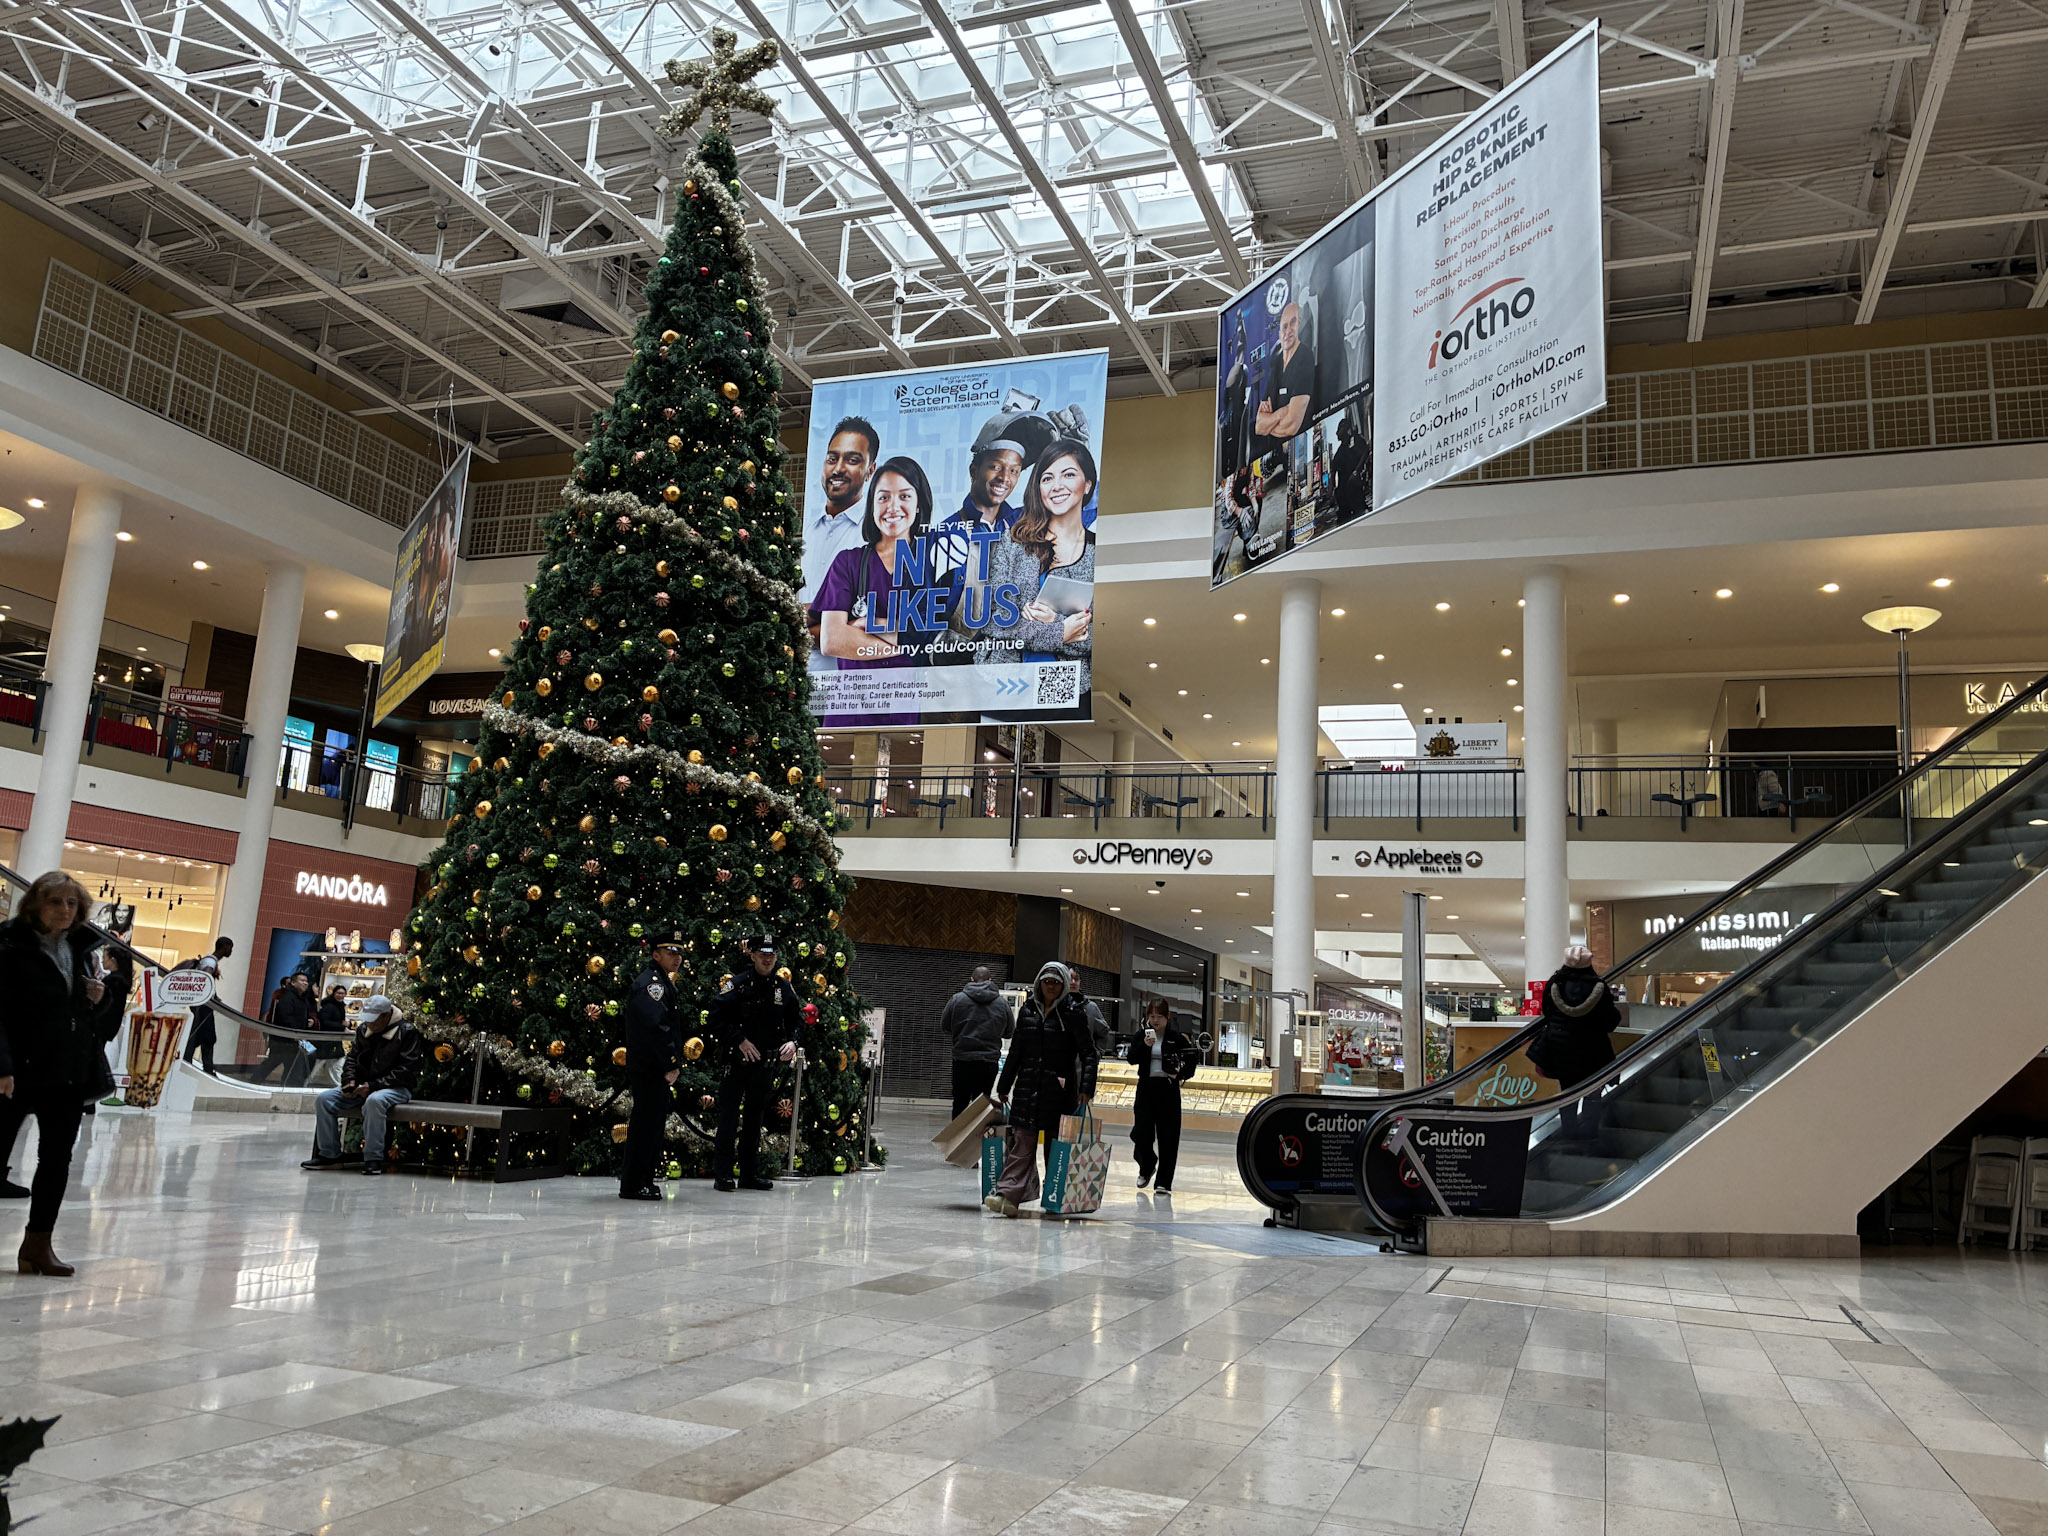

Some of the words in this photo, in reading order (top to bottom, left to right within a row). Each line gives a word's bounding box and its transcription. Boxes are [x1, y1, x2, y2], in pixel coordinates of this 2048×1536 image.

[1439, 104, 1521, 174] ROBOTIC
[1432, 166, 1461, 197] HIP
[1464, 156, 1477, 174] &
[1480, 117, 1528, 163] KNEE
[1416, 123, 1548, 228] REPLACEMENT
[1472, 177, 1516, 212] Procedure
[1444, 219, 1481, 248] Precision
[1484, 195, 1515, 220] Results
[1434, 251, 1458, 270] Same
[1461, 238, 1478, 254] Day
[1481, 206, 1525, 241] Discharge
[1415, 262, 1462, 299] Top-Ranked
[1465, 236, 1501, 268] Hospital
[1503, 208, 1550, 243] Affiliation
[1413, 286, 1455, 318] Nationally
[1457, 250, 1506, 290] Recognized
[1509, 224, 1554, 257] Expertise
[1428, 287, 1535, 370] iortho
[1424, 373, 1438, 386] THE
[1441, 344, 1493, 377] ORTHOPEDIC
[1495, 318, 1538, 348] INSTITUTE
[913, 384, 968, 396] College
[972, 379, 989, 391] of
[1361, 383, 1370, 393] MD
[1409, 403, 1425, 423] Call
[1427, 400, 1441, 415] For
[1445, 371, 1494, 405] Immediate
[1497, 338, 1559, 377] Consultation
[899, 407, 926, 415] WORKFORCE
[927, 404, 960, 412] DEVELOPMENT
[971, 400, 1000, 408] INNOVATION
[900, 396, 950, 408] Staten
[954, 388, 1000, 403] Island
[1388, 405, 1468, 453] 833-GO-iOrtho
[1491, 344, 1585, 401] iOrthoMD.com
[1391, 448, 1427, 473] TRAUMA
[1436, 417, 1486, 449] ARTHRITIS
[1498, 392, 1538, 420] SPORTS
[1550, 368, 1584, 394] SPINE
[1403, 434, 1484, 480] COMPREHENSIVE
[1488, 418, 1514, 438] CARE
[1519, 391, 1569, 424] FACILITY
[1296, 504, 1314, 520] BEST
[415, 522, 429, 551] care
[919, 520, 975, 534] THEY'RE
[1258, 543, 1277, 557] Health
[865, 587, 951, 635] LIKE
[963, 583, 1021, 630] US
[856, 639, 1025, 658] csi.cuny.edu/continue
[821, 674, 841, 683] Hiring
[844, 673, 873, 682] Partners
[843, 682, 880, 691] In-Demand
[882, 681, 929, 690] Certifications
[170, 692, 185, 700] GIFT
[186, 694, 221, 704] WRAPPING
[171, 686, 223, 698] COMPLIMENTARY
[837, 692, 868, 701] Training,
[869, 691, 892, 699] Career
[894, 690, 916, 700] Ready
[918, 689, 946, 699] Support
[830, 701, 847, 710] Built
[848, 701, 858, 709] for
[861, 701, 876, 709] Your
[877, 701, 891, 709] Life
[1462, 739, 1499, 747] LIBERTY
[1088, 842, 1197, 870] JCPenney
[1374, 845, 1463, 868] Applebee's
[296, 871, 387, 907] PANDORA
[1700, 936, 1740, 951] Italian
[168, 983, 206, 992] CRAVINGS!
[169, 975, 194, 983] CONQUER
[1478, 1063, 1537, 1106] Love
[1305, 1112, 1367, 1132] Caution
[1415, 1126, 1486, 1147] Caution
